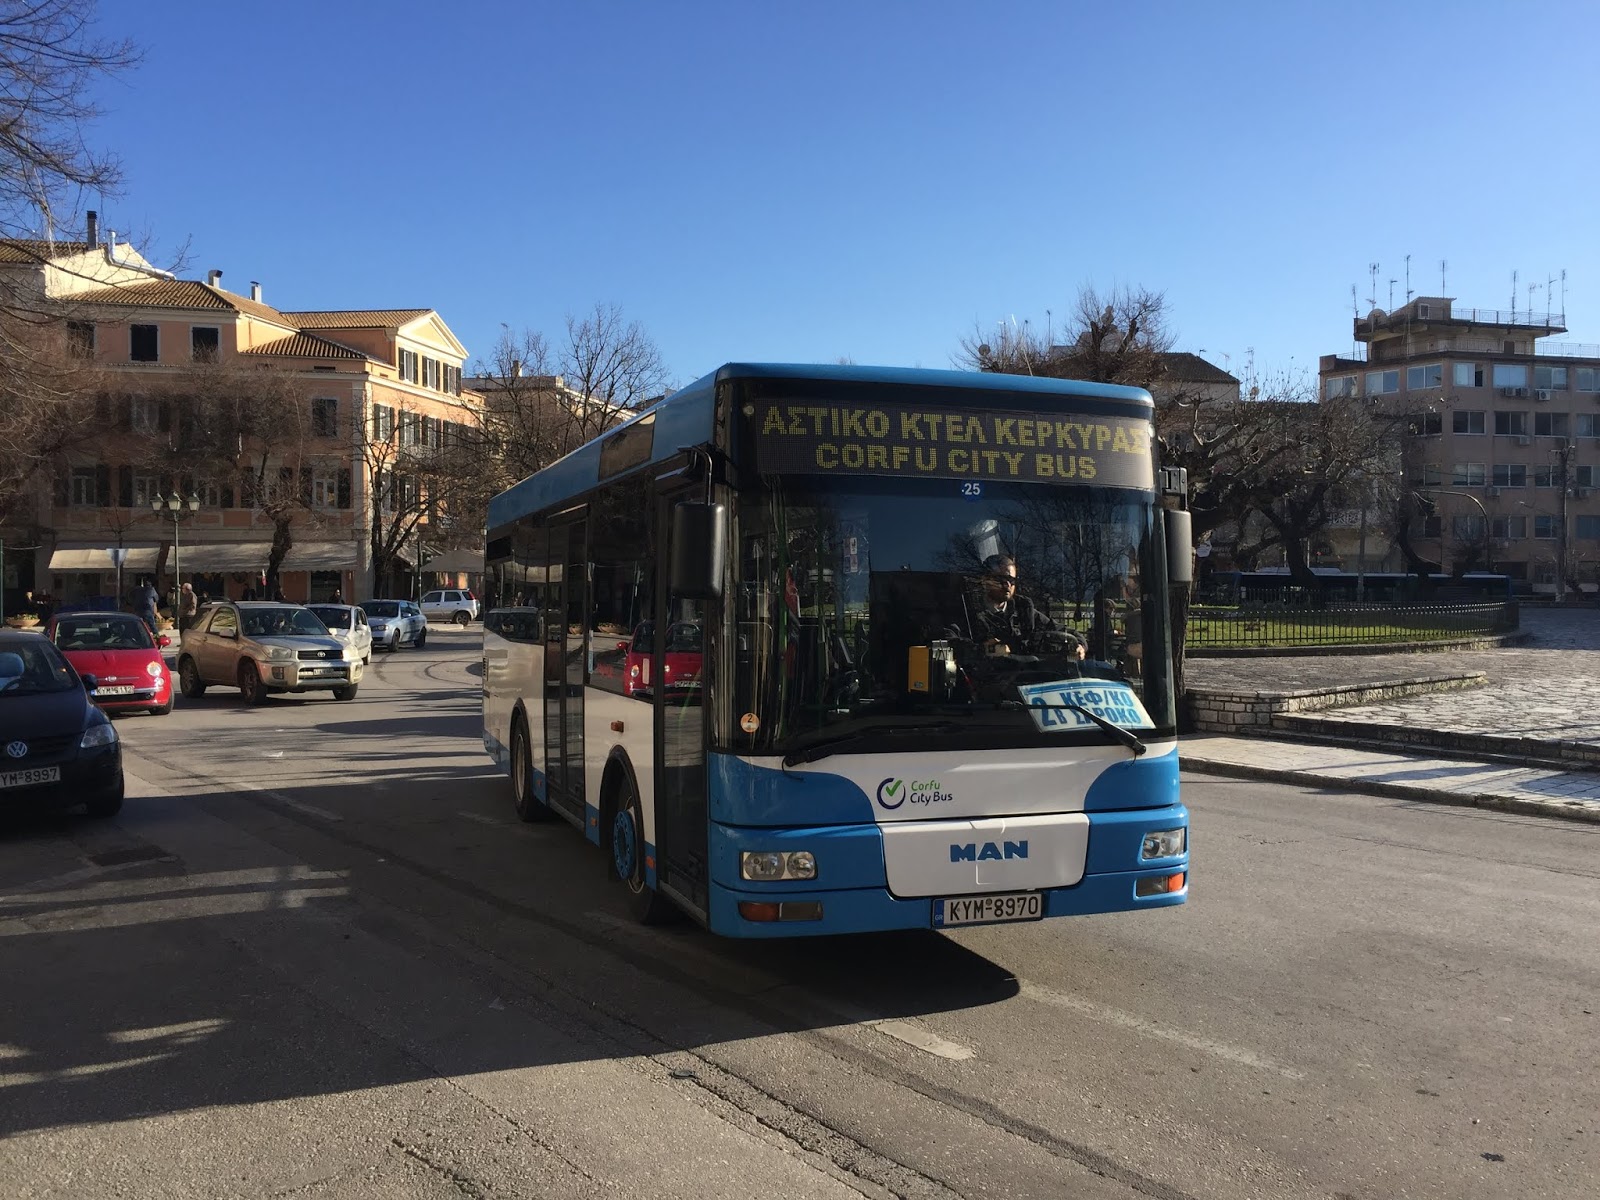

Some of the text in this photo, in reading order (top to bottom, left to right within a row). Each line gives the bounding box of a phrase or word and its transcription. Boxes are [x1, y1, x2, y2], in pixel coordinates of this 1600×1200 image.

[762, 406, 1145, 455] ΑΣΤΙΚΟ ΚΤΕΛ ΚΕΡΚΥΡΑΣ
[816, 442, 1097, 479] CORFU CITY BUS
[964, 482, 981, 496] 25
[1059, 689, 1134, 708] ΚΕΦ/ΚΟ
[911, 780, 941, 792] Corfu
[910, 791, 953, 806] City Bus
[950, 840, 1028, 862] MAN
[950, 896, 1038, 921] KYM-8970
